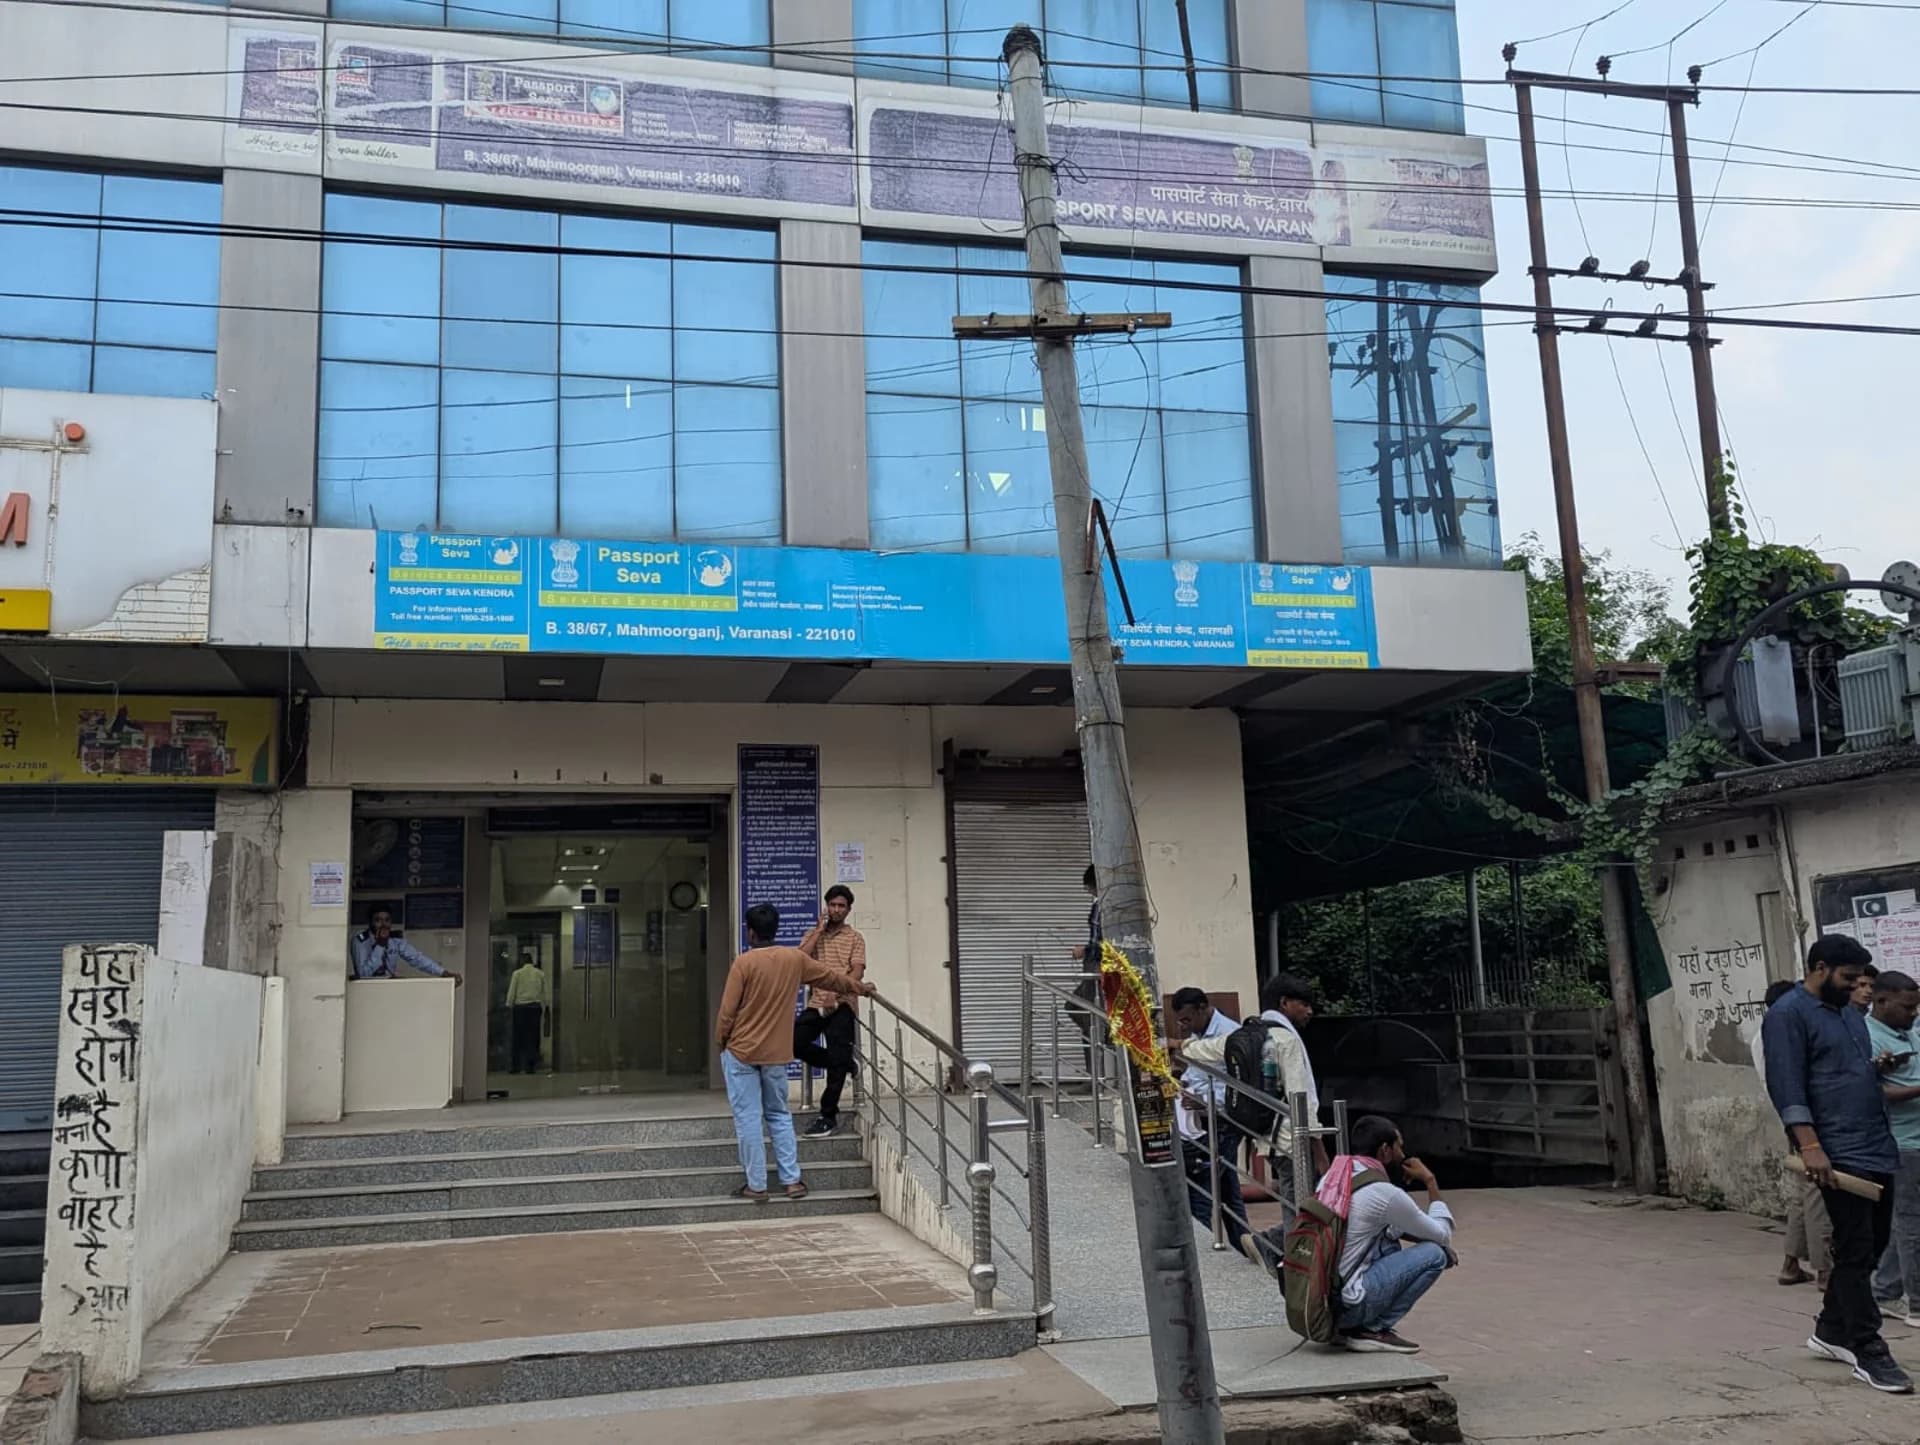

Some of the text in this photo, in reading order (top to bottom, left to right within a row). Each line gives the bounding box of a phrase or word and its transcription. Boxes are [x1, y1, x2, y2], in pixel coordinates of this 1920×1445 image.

[514, 76, 577, 94] Passport
[695, 171, 740, 186] 221010
[1150, 184, 1206, 204] पासपोर्ट
[1210, 185, 1239, 208] सेवा
[1123, 206, 1168, 225] SEVA
[1172, 211, 1250, 233] KENDRA,
[1256, 216, 1313, 237] VARAN
[430, 535, 481, 548] Passport
[441, 548, 471, 559] Seva
[598, 547, 681, 567] Passport
[616, 568, 661, 584] Seva
[1291, 575, 1314, 585] Seva
[389, 586, 515, 598] PASSPORT SEVA KENDRA
[546, 621, 561, 635] B.
[567, 622, 612, 638] 38/67,
[616, 623, 724, 641] Mahmoorganj,
[729, 626, 792, 640] Varanasi
[805, 628, 856, 641] 221010
[1193, 640, 1235, 649] VARANASI
